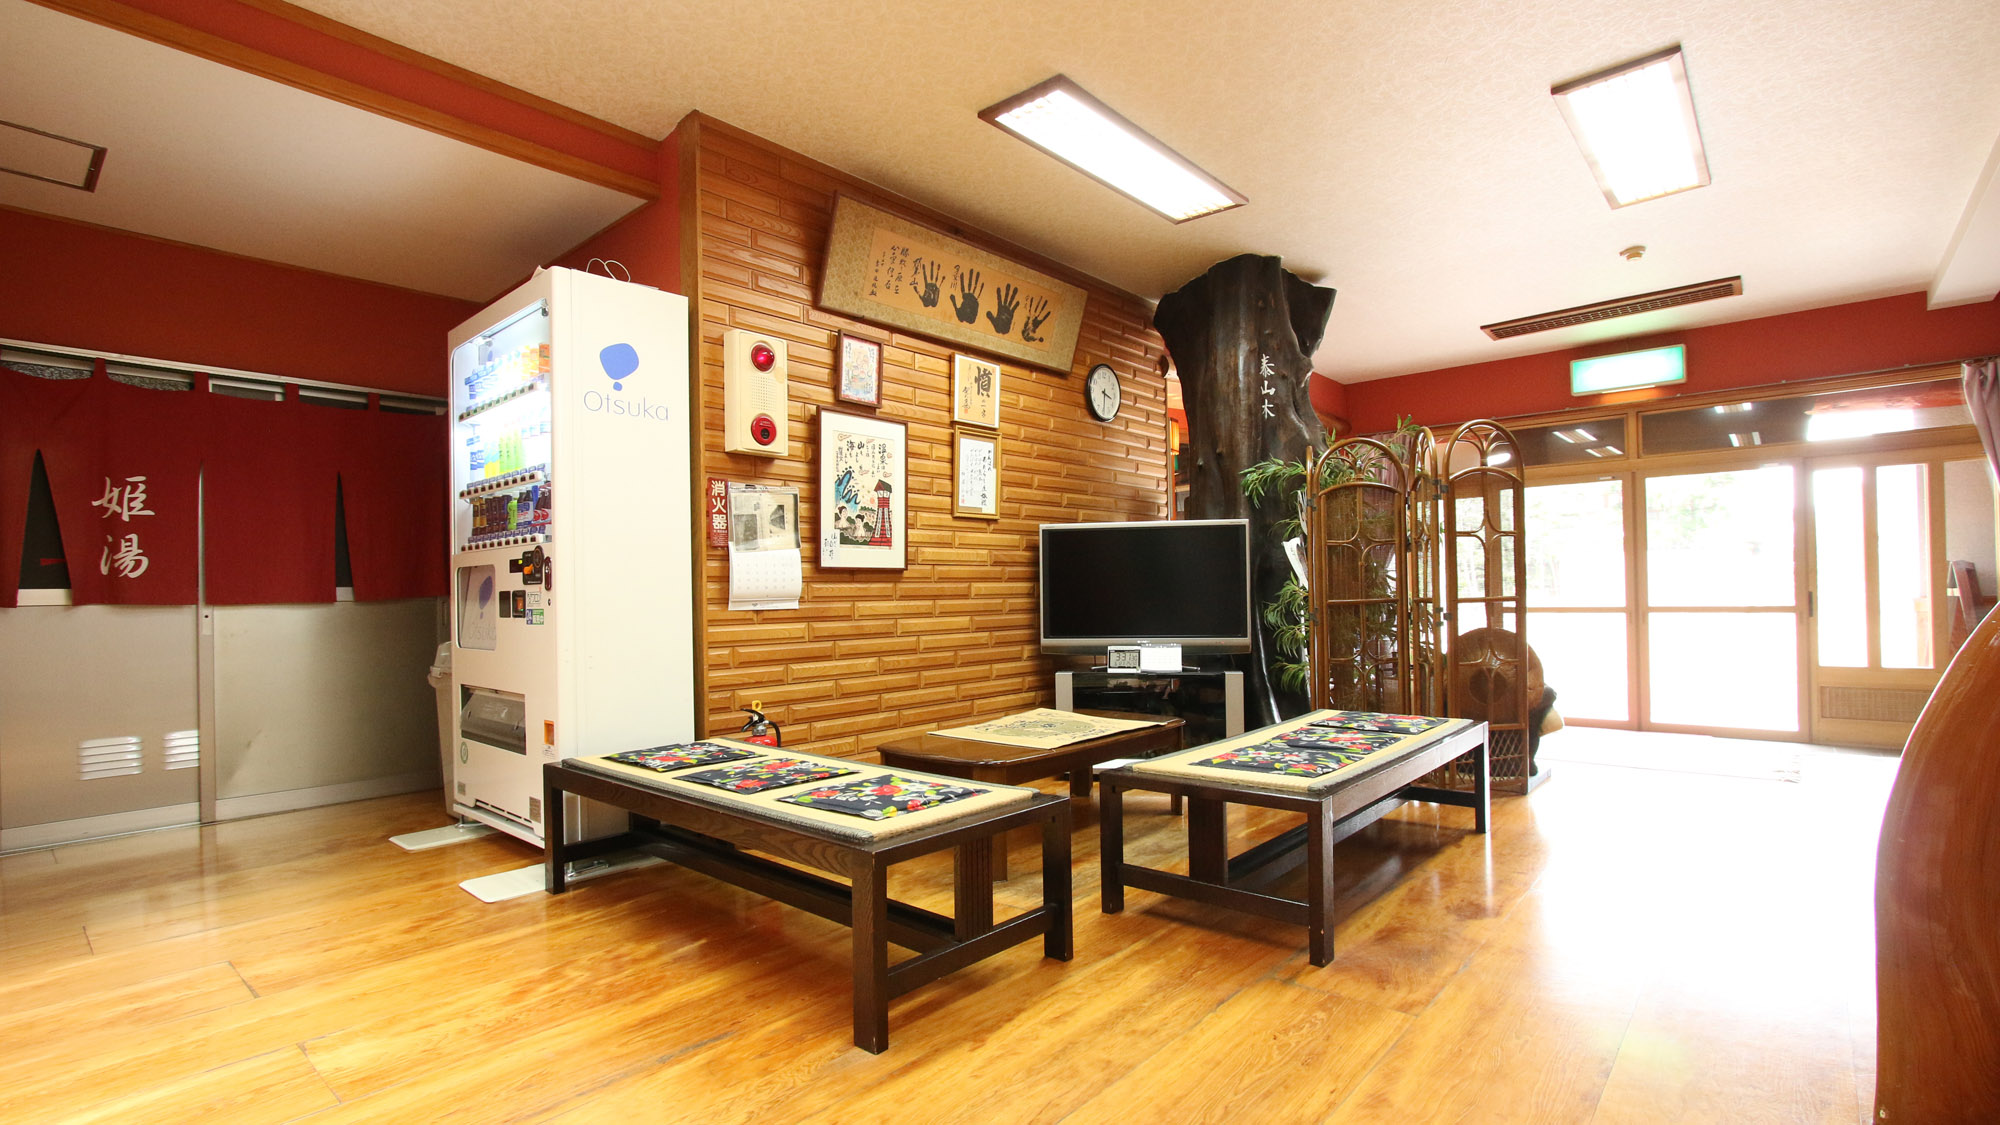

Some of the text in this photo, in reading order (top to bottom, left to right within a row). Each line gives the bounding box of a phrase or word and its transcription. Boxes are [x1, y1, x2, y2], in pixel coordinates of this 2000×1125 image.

[583, 390, 669, 421] Otsuka
[1259, 353, 1276, 420] 泰山木
[91, 475, 156, 579] 姫湯
[711, 480, 728, 530] 消火器
